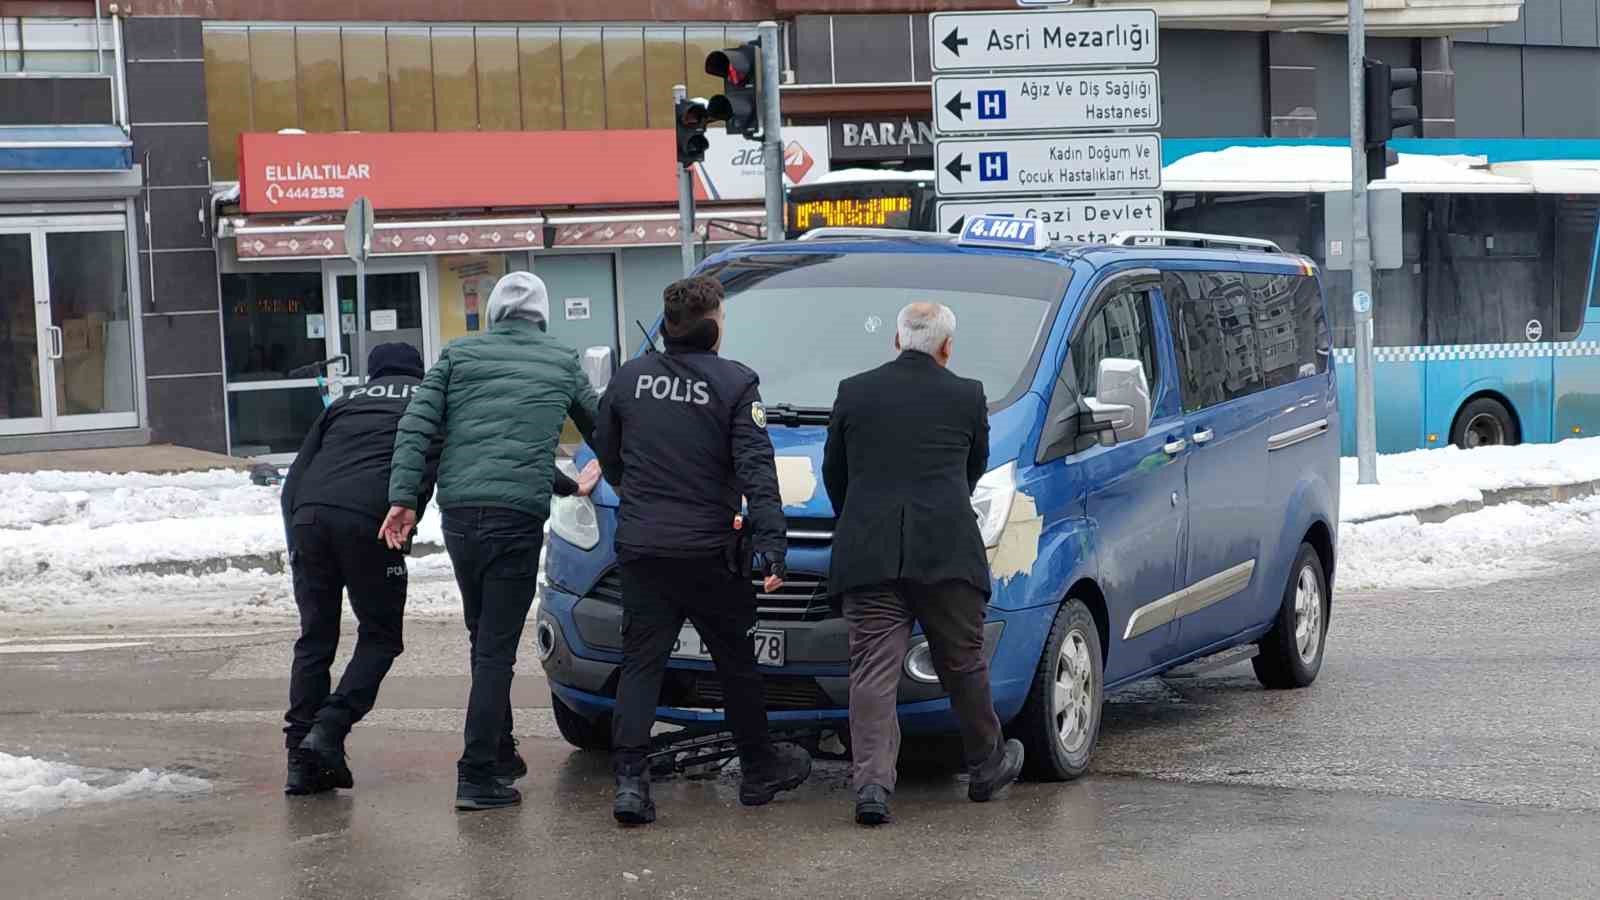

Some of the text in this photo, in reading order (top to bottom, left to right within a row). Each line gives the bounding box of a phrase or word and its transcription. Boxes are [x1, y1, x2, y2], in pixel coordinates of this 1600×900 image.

[986, 24, 1149, 51] Asri Mezarlığı
[1020, 80, 1151, 100] Ağız Ve Diş Sağlığı
[1086, 103, 1152, 119] Hastanesi
[731, 148, 765, 166] ara
[1049, 144, 1150, 162] Kadın Doğum Ve
[265, 161, 371, 181] ELLİALTILAR
[1018, 168, 1054, 185] Çocuk
[1060, 167, 1125, 182] Hastalıkları
[1025, 204, 1152, 223] Gazi Devlet
[970, 218, 1034, 240] 4.HAT
